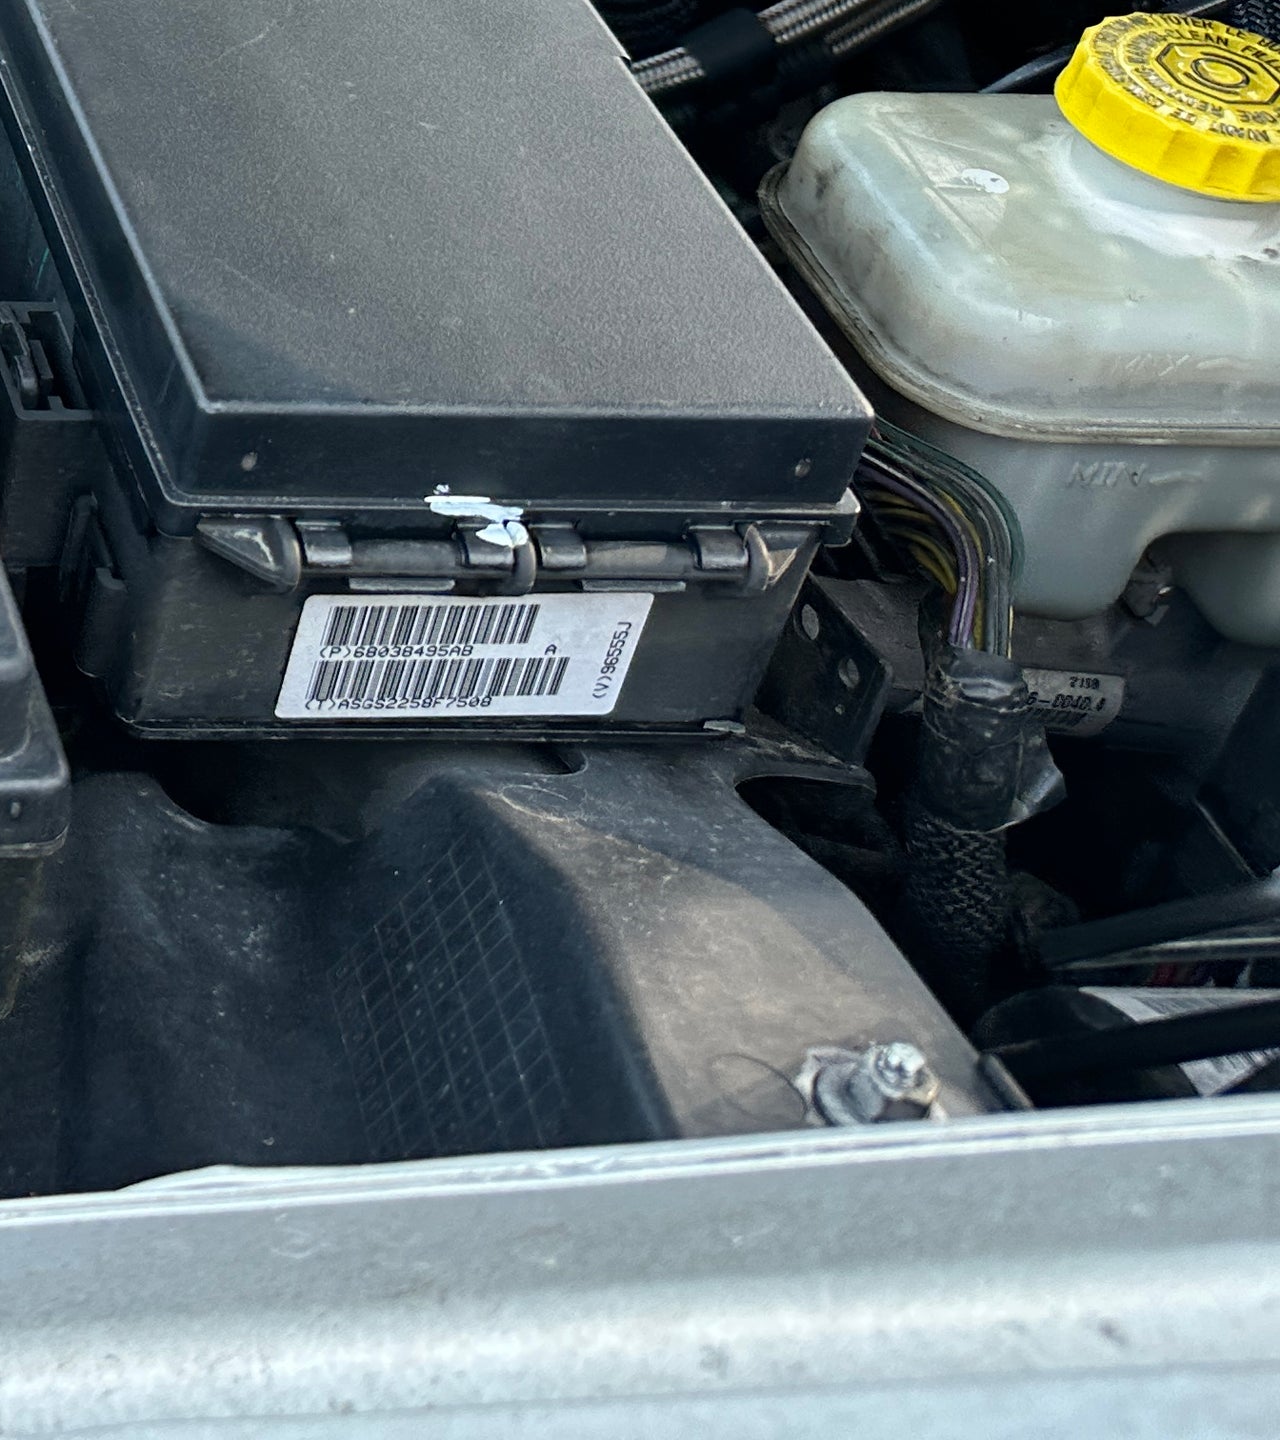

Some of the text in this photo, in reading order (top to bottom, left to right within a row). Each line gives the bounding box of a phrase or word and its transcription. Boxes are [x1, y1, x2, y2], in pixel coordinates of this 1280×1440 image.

[1165, 29, 1229, 46] CLEAN
[319, 645, 558, 658] (P)68038495AB A
[592, 621, 632, 699] (V)96555J
